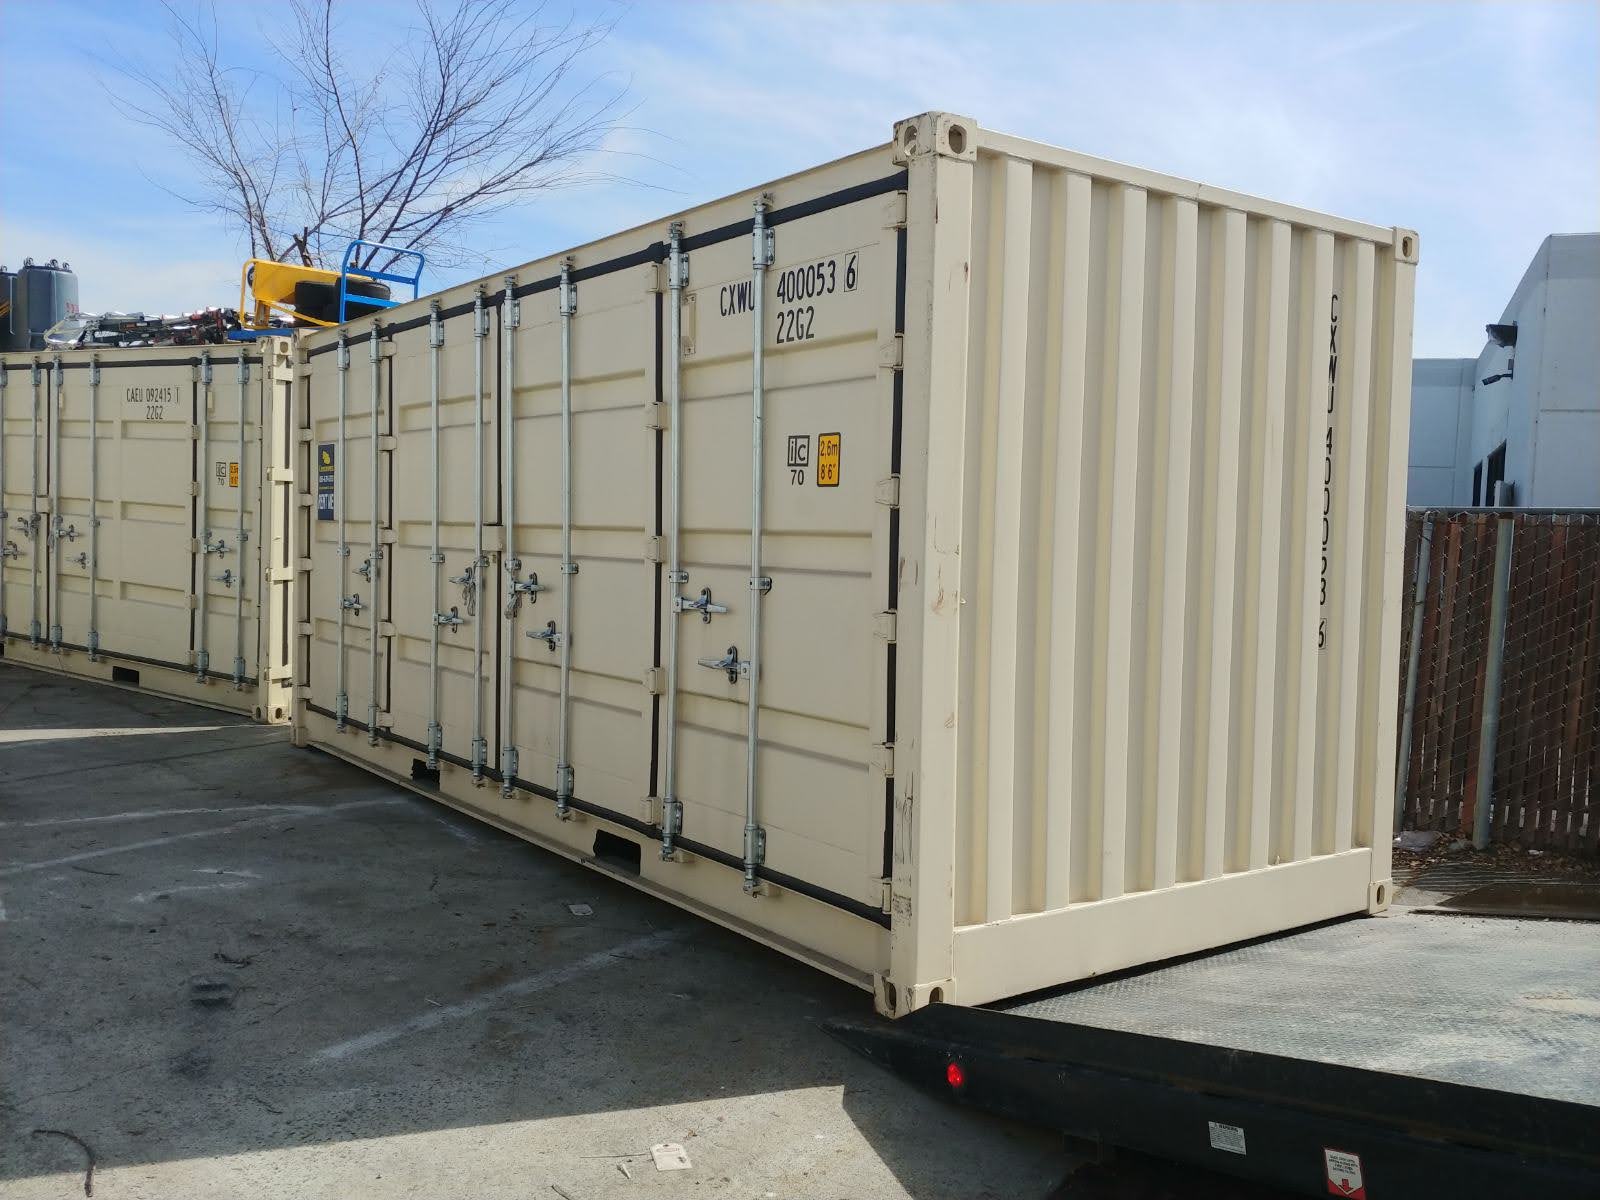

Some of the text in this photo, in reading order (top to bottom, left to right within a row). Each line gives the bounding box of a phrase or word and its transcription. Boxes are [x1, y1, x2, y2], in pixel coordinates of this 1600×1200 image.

[720, 254, 857, 317] CXWU 400053 6
[776, 305, 815, 344] 22G2
[126, 387, 143, 403] CAEU
[146, 387, 172, 403] 092415
[146, 405, 164, 420] 22G2
[790, 469, 805, 486] 70
